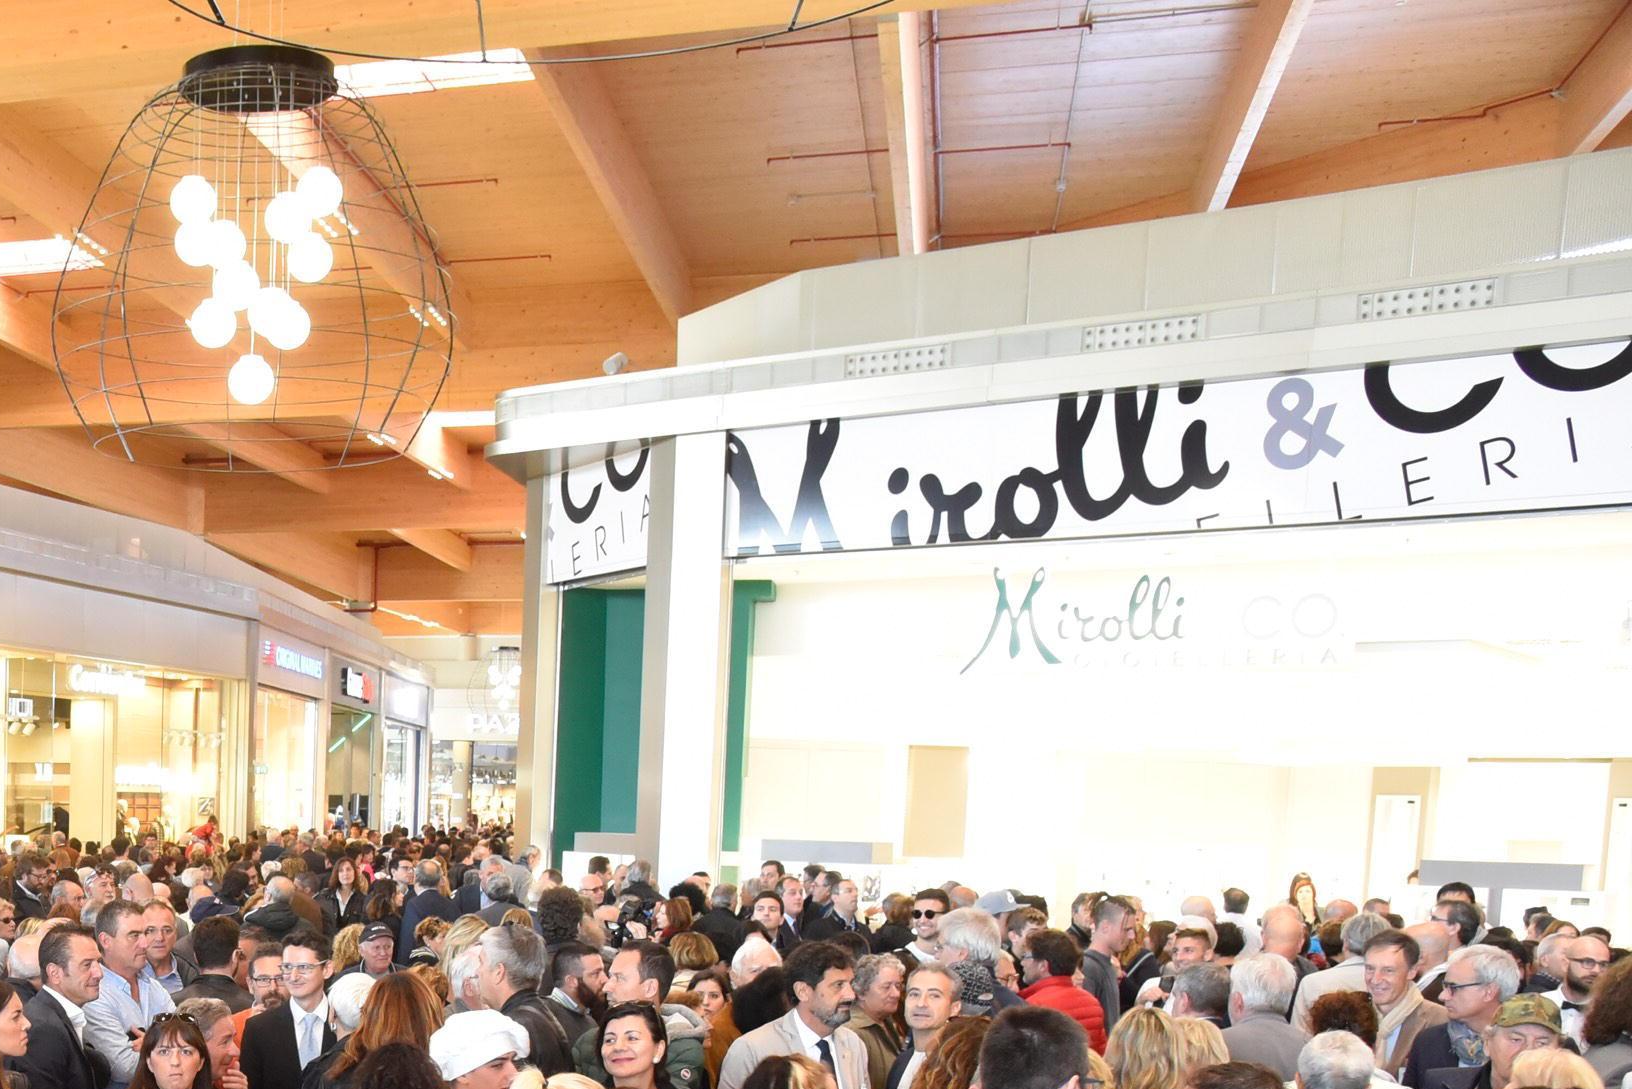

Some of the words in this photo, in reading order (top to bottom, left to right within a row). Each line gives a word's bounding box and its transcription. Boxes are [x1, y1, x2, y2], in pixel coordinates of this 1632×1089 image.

[729, 380, 1229, 553] Mirolli
[1263, 378, 1345, 470] &
[960, 566, 1185, 675] Mirolli
